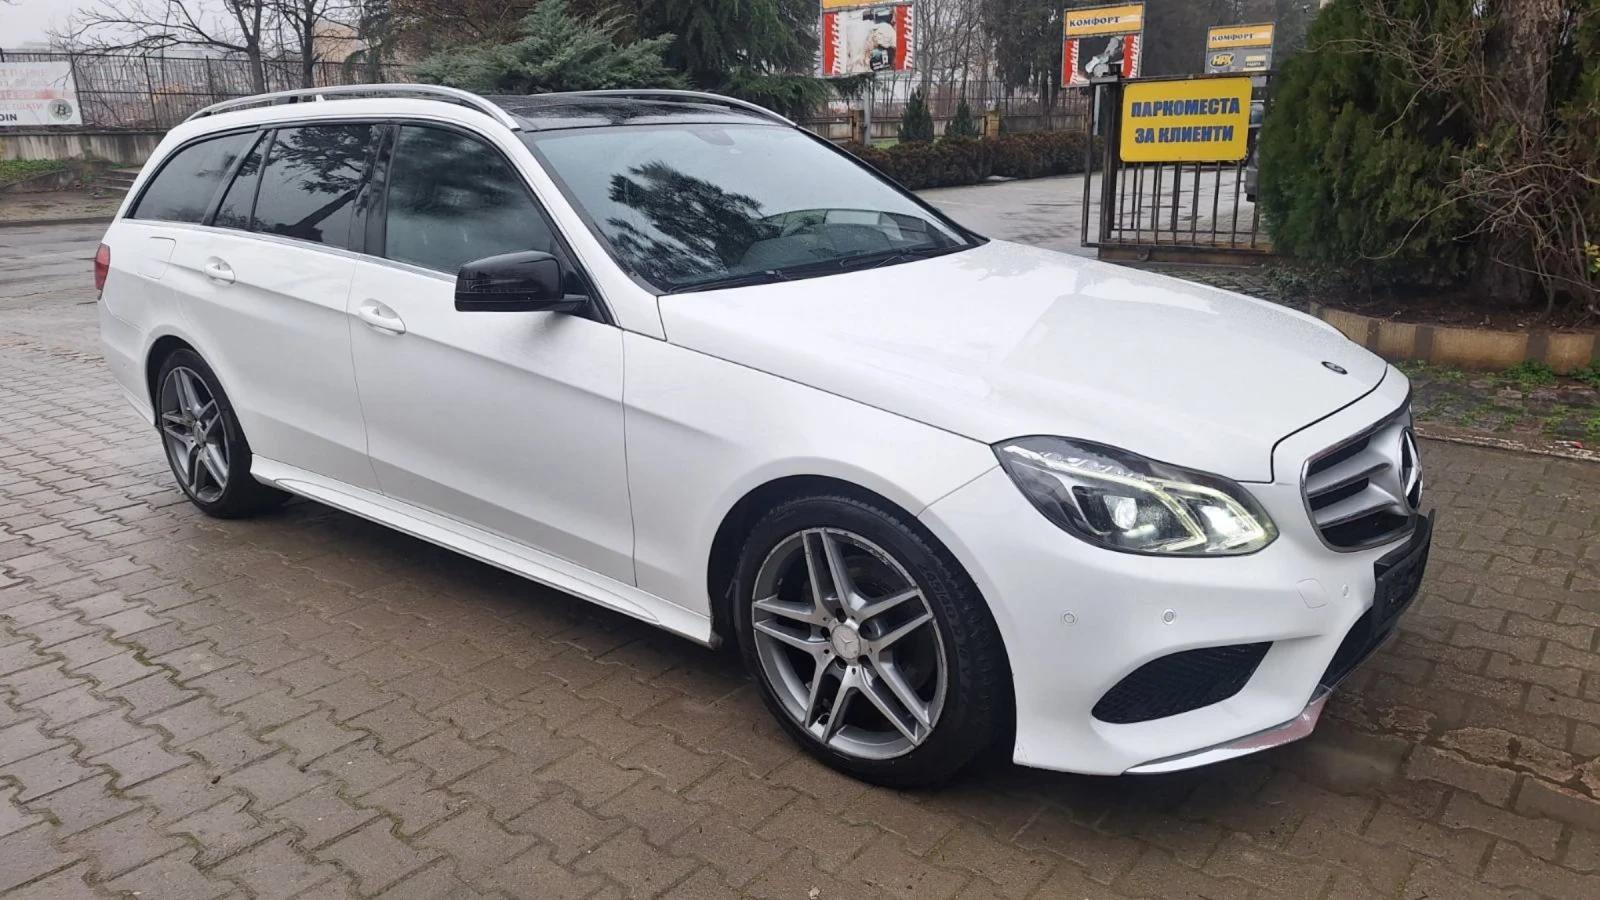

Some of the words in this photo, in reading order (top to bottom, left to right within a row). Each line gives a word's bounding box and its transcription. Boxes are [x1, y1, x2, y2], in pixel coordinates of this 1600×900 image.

[1069, 16, 1120, 27] КОМФОРТ
[832, 13, 841, 75] makita
[904, 5, 913, 70] makita
[1212, 33, 1253, 42] КОМФОРТ
[1131, 98, 1240, 117] ПАРКОМЕСТА
[1134, 128, 1155, 144] ЗА
[1158, 126, 1234, 143] КЛИЕНТИ
